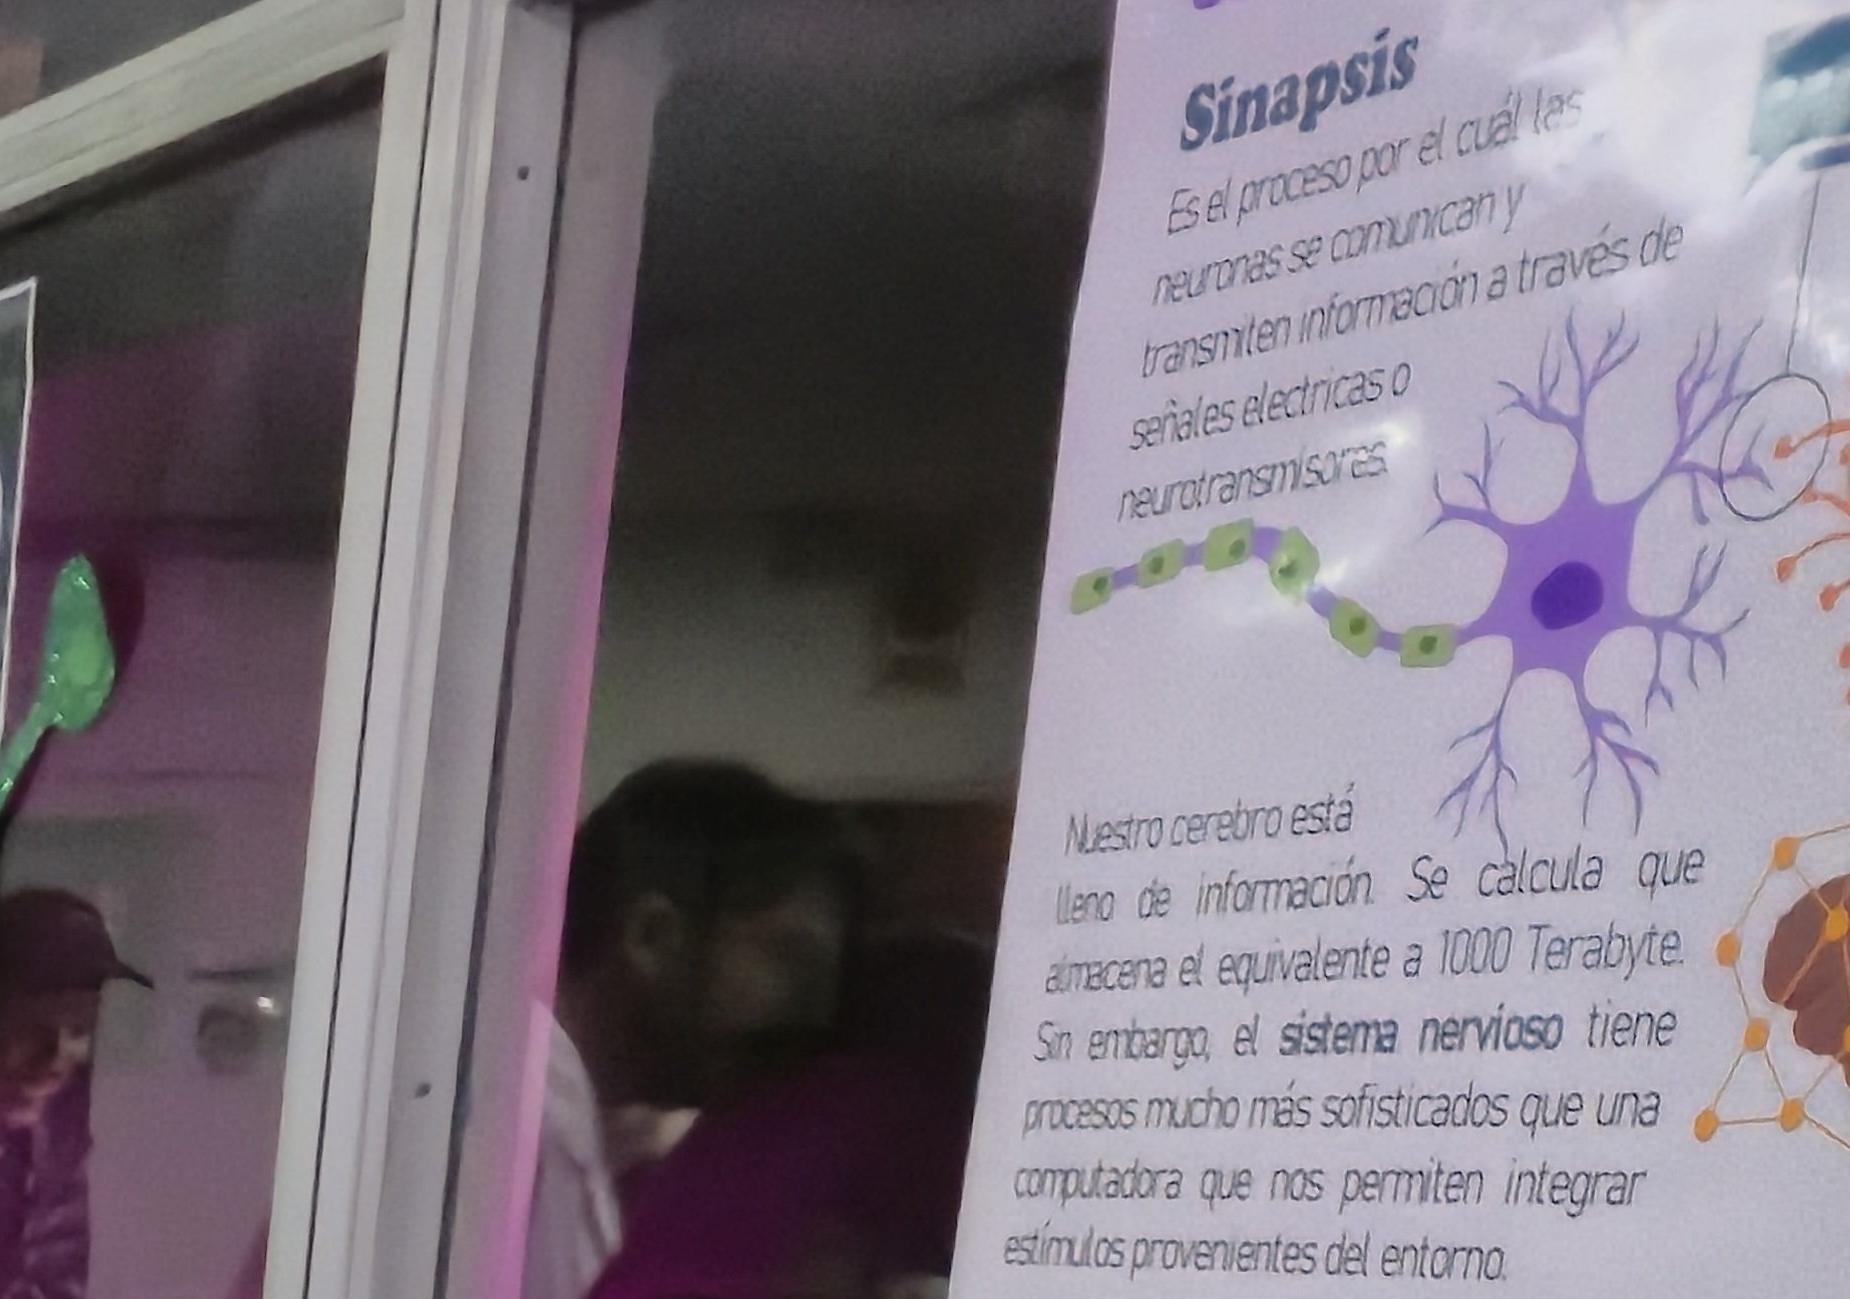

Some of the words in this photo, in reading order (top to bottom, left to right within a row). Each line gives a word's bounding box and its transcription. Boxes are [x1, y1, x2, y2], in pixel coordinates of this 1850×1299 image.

[1179, 27, 1419, 151] Sinapsis
[1168, 187, 1200, 236] Es
[1207, 178, 1231, 222] el
[1237, 154, 1351, 226] proceso
[1357, 137, 1411, 194] por
[1419, 116, 1446, 166] el
[1152, 245, 1285, 306] neuronas
[1288, 234, 1323, 274] se
[1331, 192, 1495, 263] comunican
[1503, 182, 1525, 234] y
[1141, 313, 1291, 378] transmiten
[1298, 257, 1479, 343] información
[1487, 264, 1508, 301] a
[1518, 222, 1629, 294] través
[1639, 216, 1684, 267] de
[1129, 395, 1235, 450] señales
[1392, 362, 1411, 397] o
[1065, 812, 1163, 855] Nuestro
[1170, 798, 1283, 847] cerebro
[1291, 782, 1355, 836] está
[1138, 878, 1171, 920] de
[1407, 854, 1448, 901] Se
[1478, 844, 1603, 897] calcula
[1637, 847, 1705, 901] que
[1179, 942, 1203, 987] el
[1218, 936, 1391, 996] equivalente
[1403, 942, 1423, 977] a
[1440, 926, 1513, 974] 1000
[1033, 1020, 1072, 1061] Sin
[1233, 1012, 1259, 1057] el
[1279, 1009, 1399, 1055] sistema
[1418, 1002, 1564, 1053] nervioso
[1587, 999, 1678, 1048] tiene
[1022, 1098, 1138, 1140] procesos
[1144, 1086, 1240, 1128] mucho
[1250, 1079, 1313, 1128] más
[1320, 1080, 1509, 1128] sofisticados
[1519, 1090, 1584, 1141] que
[1596, 1089, 1662, 1128] una
[1013, 1158, 1184, 1210] computadora
[1200, 1167, 1253, 1211] que
[1270, 1168, 1325, 1201] nos
[1339, 1157, 1484, 1215] permiten
[1504, 1157, 1648, 1218] integrar
[1002, 1219, 1126, 1269] estímulos
[1129, 1233, 1318, 1282] provenientes
[1325, 1230, 1371, 1277] del
